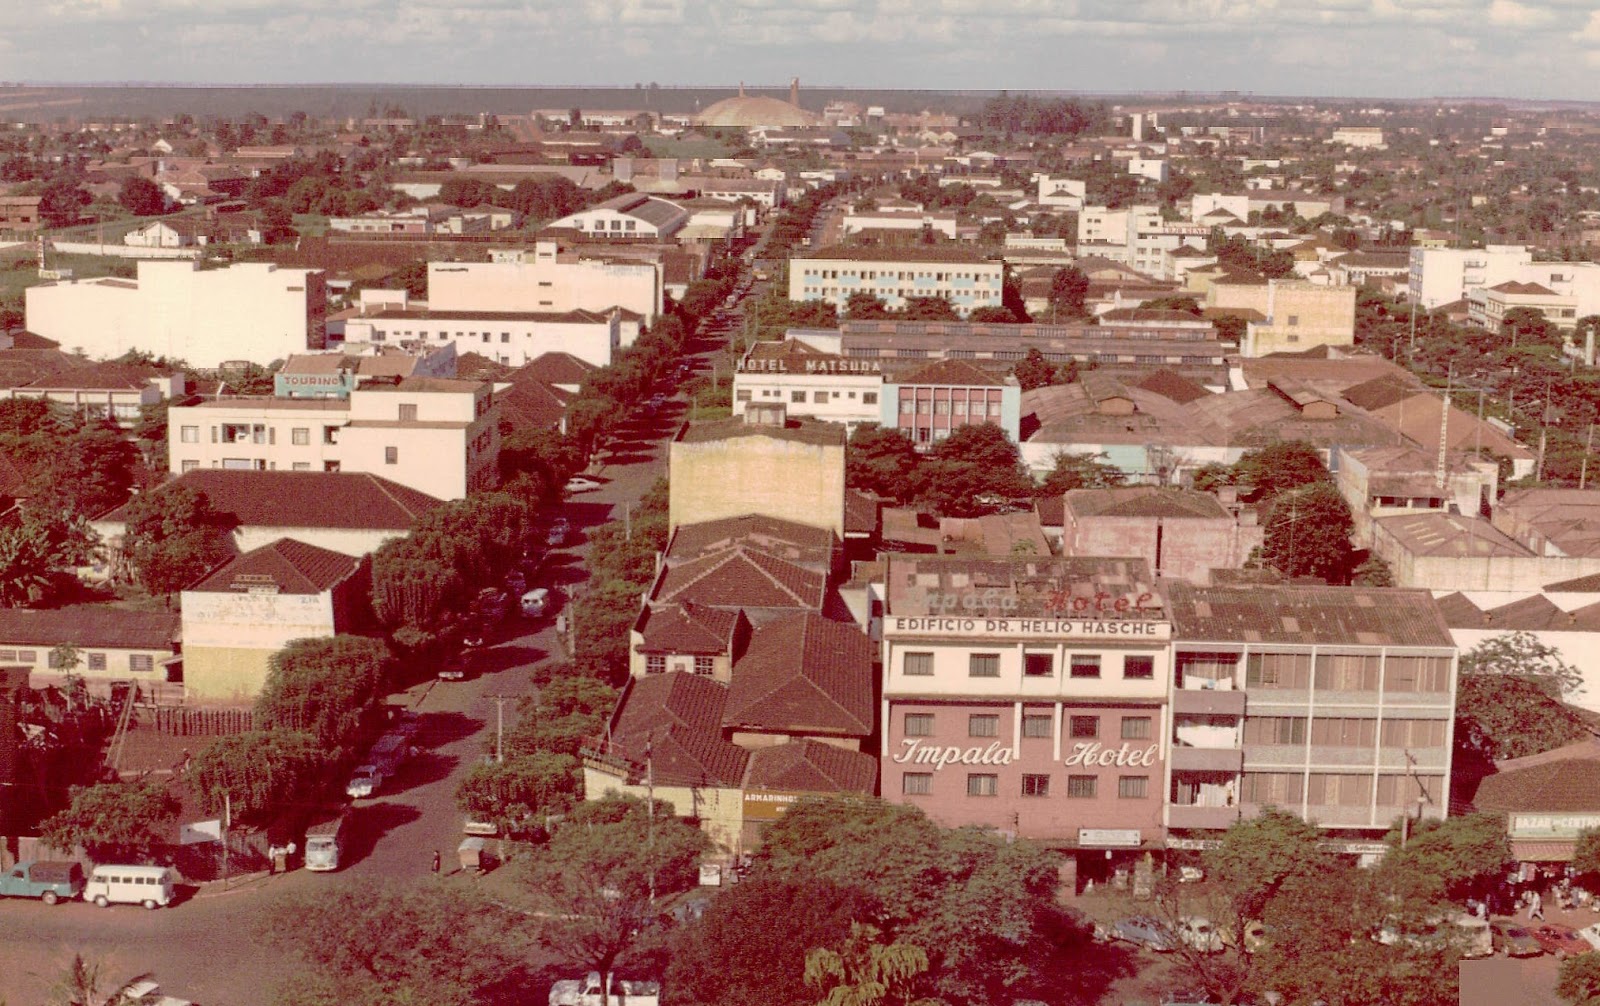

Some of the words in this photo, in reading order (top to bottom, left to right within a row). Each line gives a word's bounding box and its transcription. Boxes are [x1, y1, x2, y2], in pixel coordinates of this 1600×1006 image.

[736, 359, 787, 370] HOTEL
[805, 360, 881, 371] MATSUDA
[284, 376, 339, 385] TOURING
[1043, 586, 1153, 611] Hotel
[896, 620, 975, 630] EDIFICIO
[985, 621, 1015, 632] DR.
[1021, 621, 1072, 633] HELIO
[1082, 622, 1156, 635] HASCHE
[893, 738, 1014, 770] Impala
[1064, 742, 1159, 769] Hotel
